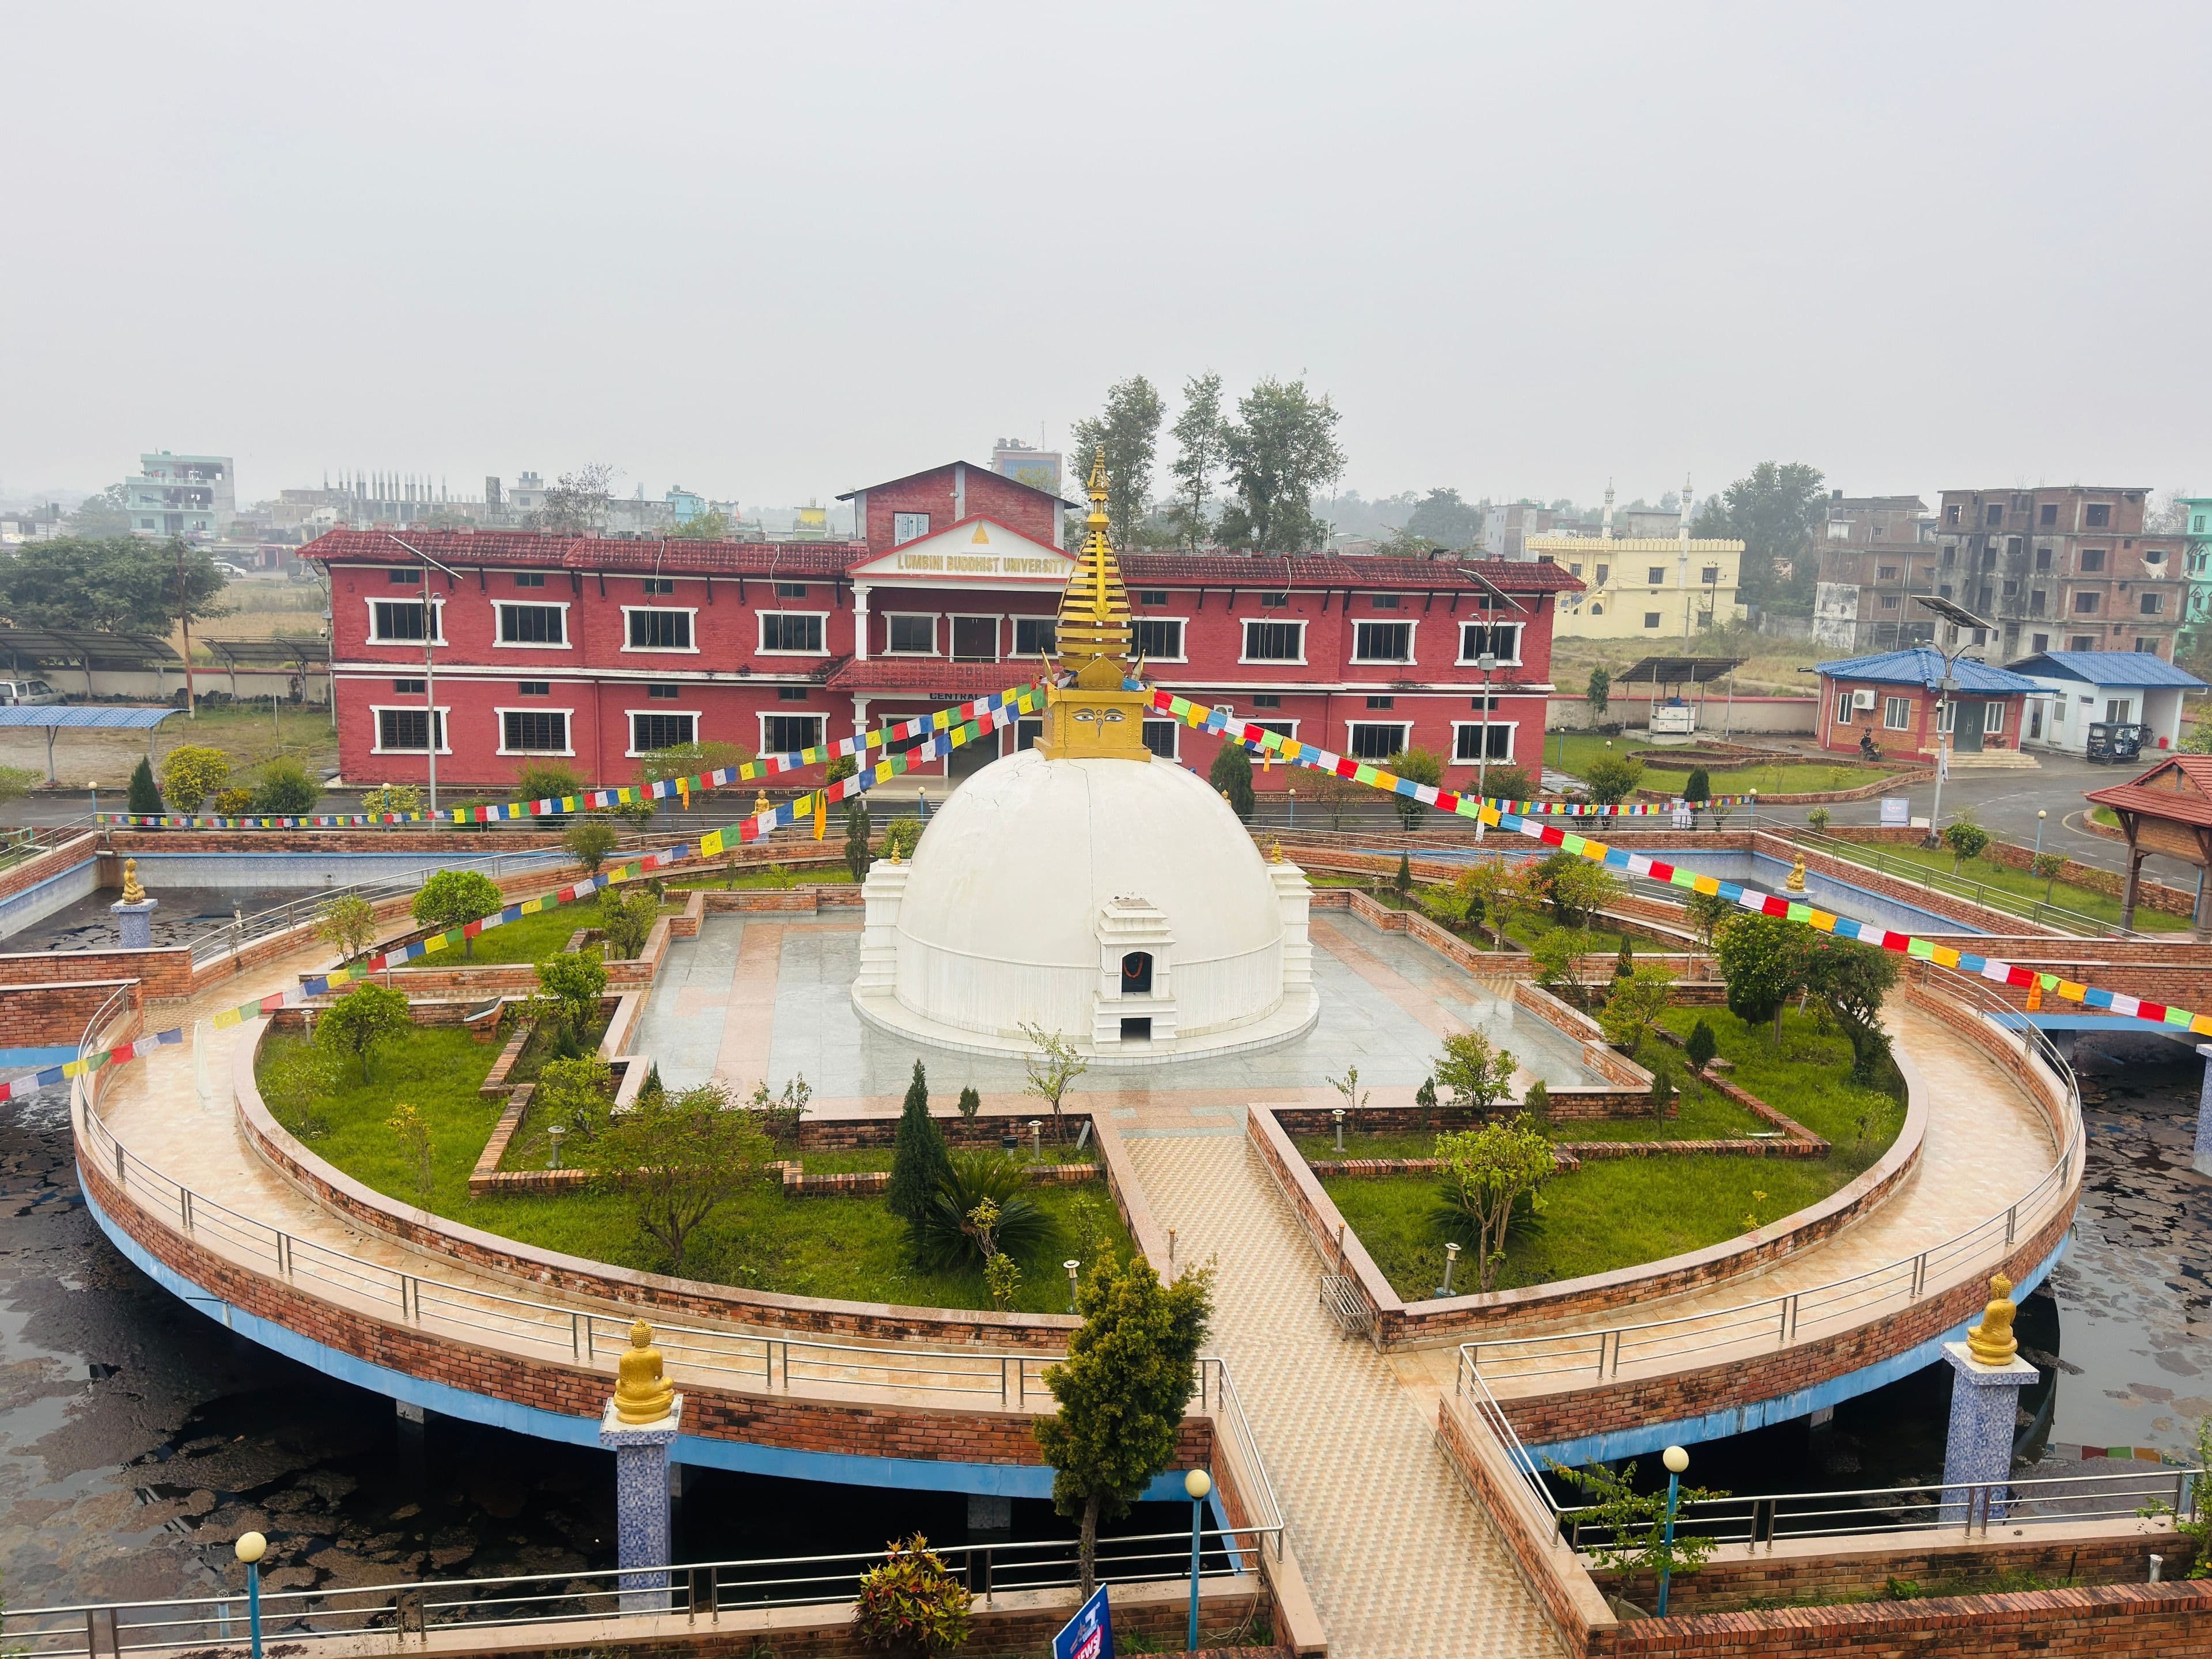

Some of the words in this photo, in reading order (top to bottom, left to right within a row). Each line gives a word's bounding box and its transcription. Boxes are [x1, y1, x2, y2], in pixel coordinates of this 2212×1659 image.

[898, 554, 944, 570] LUMBINI
[946, 555, 999, 572] BUDDHIST
[1003, 558, 1068, 574] UNIVERSITY
